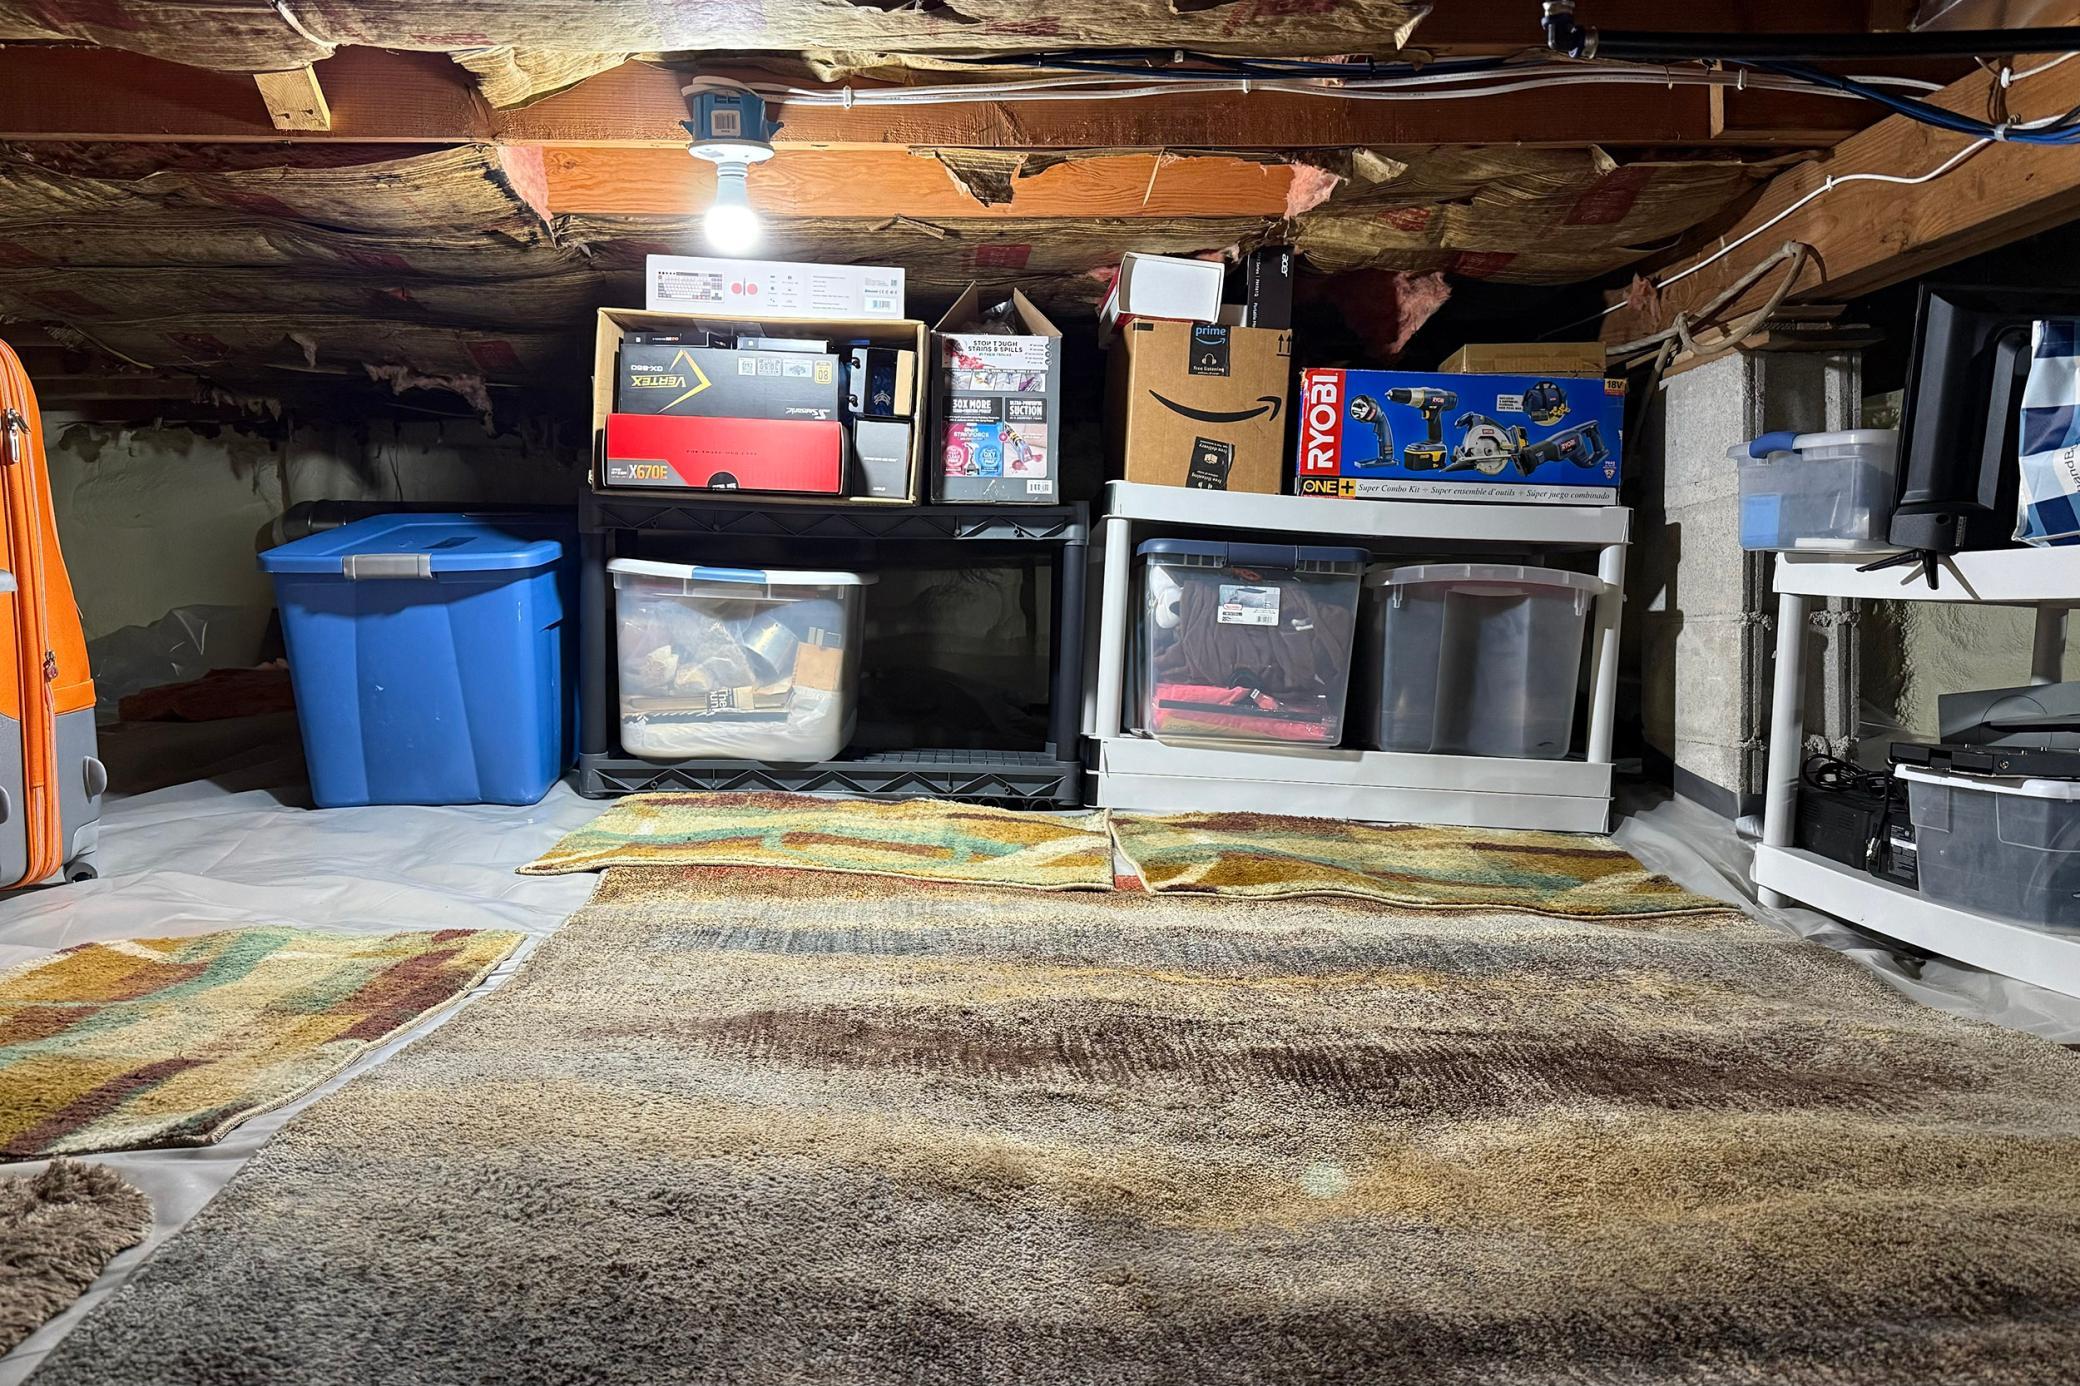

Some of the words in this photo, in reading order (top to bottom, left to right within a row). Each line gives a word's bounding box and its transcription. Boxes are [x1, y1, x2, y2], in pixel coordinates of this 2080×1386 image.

[1281, 253, 1289, 278] acer
[1195, 325, 1226, 337] prime
[631, 375, 687, 388] VERTEX
[1606, 380, 1624, 389] 18V
[952, 398, 968, 409] 30X
[969, 399, 992, 409] MORE
[1009, 405, 1043, 416] SUCTION
[1307, 375, 1338, 470] RYOBI
[628, 464, 668, 480] X670E
[1359, 484, 1379, 493] Super
[1381, 484, 1407, 493] Combo
[1408, 485, 1420, 493] Kit
[1431, 486, 1451, 496] Super
[1453, 487, 1487, 496] ensemble
[1488, 488, 1515, 496] d'outils
[1548, 489, 1569, 499] juego
[1570, 490, 1610, 500] combinado
